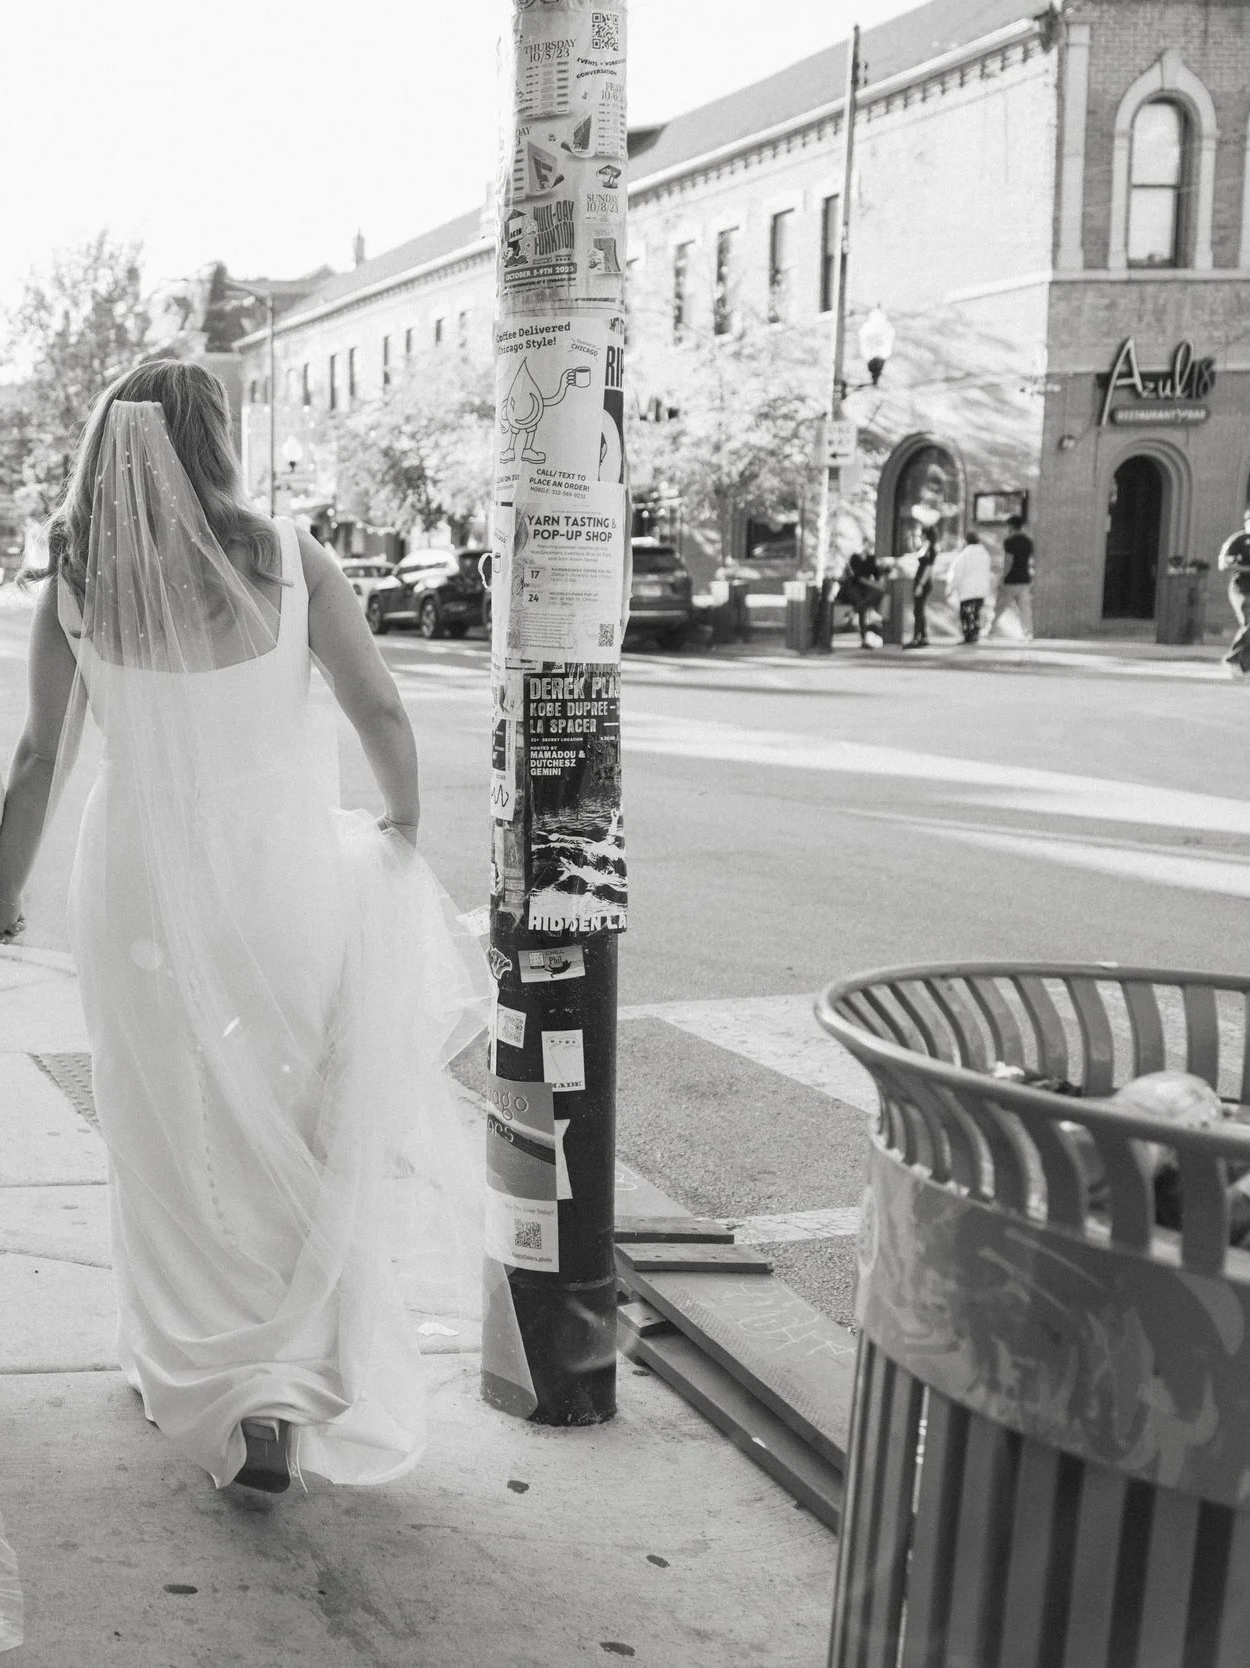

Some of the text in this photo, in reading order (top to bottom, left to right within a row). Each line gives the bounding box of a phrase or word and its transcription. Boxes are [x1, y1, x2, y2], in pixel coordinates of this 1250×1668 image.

[524, 39, 577, 55] THURSDAY
[530, 48, 570, 63] 10/5/23
[576, 57, 598, 66] EVENTS
[587, 194, 619, 203] SUNDAY
[586, 202, 619, 214] 10/8/23
[505, 271, 531, 280] OCTOBER
[496, 321, 571, 343] Coffee Delivered
[525, 337, 557, 349] Style!
[571, 343, 598, 357] CHICAGO
[1100, 336, 1194, 426] Azul
[1117, 408, 1175, 420] RESTAURANT
[537, 468, 586, 482] CALL/ TEXT TO
[529, 477, 590, 492] PLACE AN ORDER!
[530, 486, 551, 495] MOBILE:
[527, 515, 617, 529] YARN TASTING &
[533, 529, 613, 542] POP-UP SHOP
[530, 570, 540, 580] 17
[528, 593, 540, 602] 24
[530, 677, 586, 700] DEREK
[529, 702, 562, 717] KOBE
[529, 718, 597, 734] LA SPACER
[530, 750, 586, 759] MAMADOU &
[530, 759, 576, 767] DUTCHESZ
[530, 768, 561, 776] GEMINI
[528, 915, 602, 931] HIDDEN
